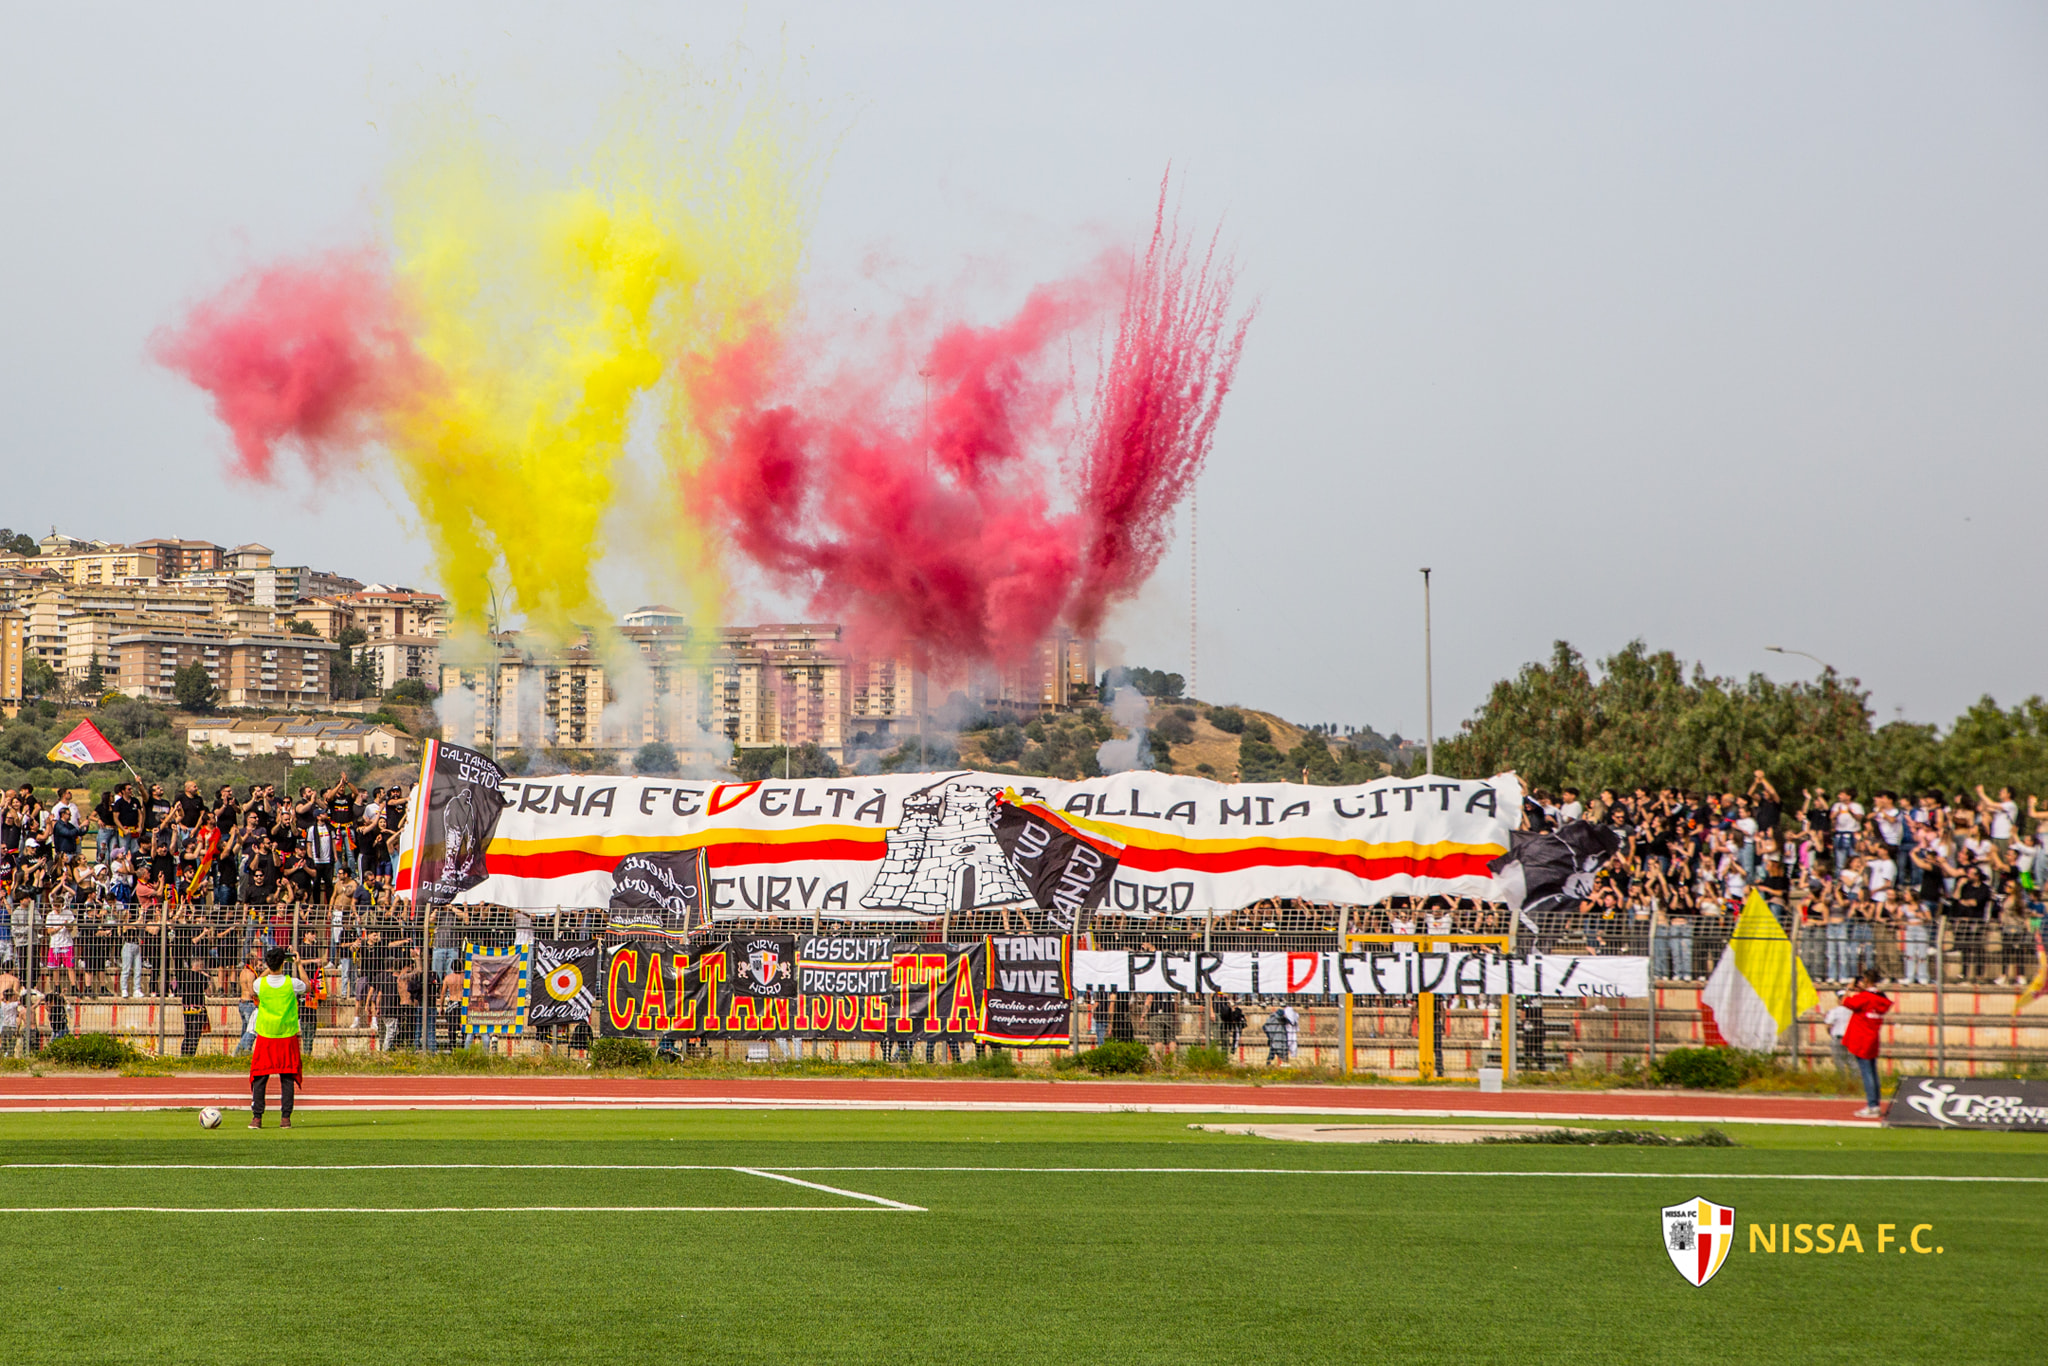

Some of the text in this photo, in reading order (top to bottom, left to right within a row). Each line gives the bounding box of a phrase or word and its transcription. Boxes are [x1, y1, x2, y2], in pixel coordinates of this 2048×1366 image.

[640, 780, 885, 824] FEDELTÀ
[1064, 789, 1196, 825] ALLA
[1219, 796, 1310, 826] MIA
[1333, 781, 1497, 819] CITTÀ
[711, 876, 1194, 915] CURVA ORD
[542, 946, 564, 960] Old
[746, 939, 780, 953] CURVA
[803, 938, 890, 960] ASSENTI
[993, 936, 1061, 962] TANO
[749, 982, 782, 996] NORD
[803, 970, 887, 993] PRESENTI
[999, 969, 1060, 994] VIVE
[530, 1004, 555, 1019] Old
[988, 998, 1025, 1011] Teschio
[1027, 1003, 1035, 1011] e
[1028, 1016, 1046, 1025] con
[1047, 1015, 1065, 1025] noi
